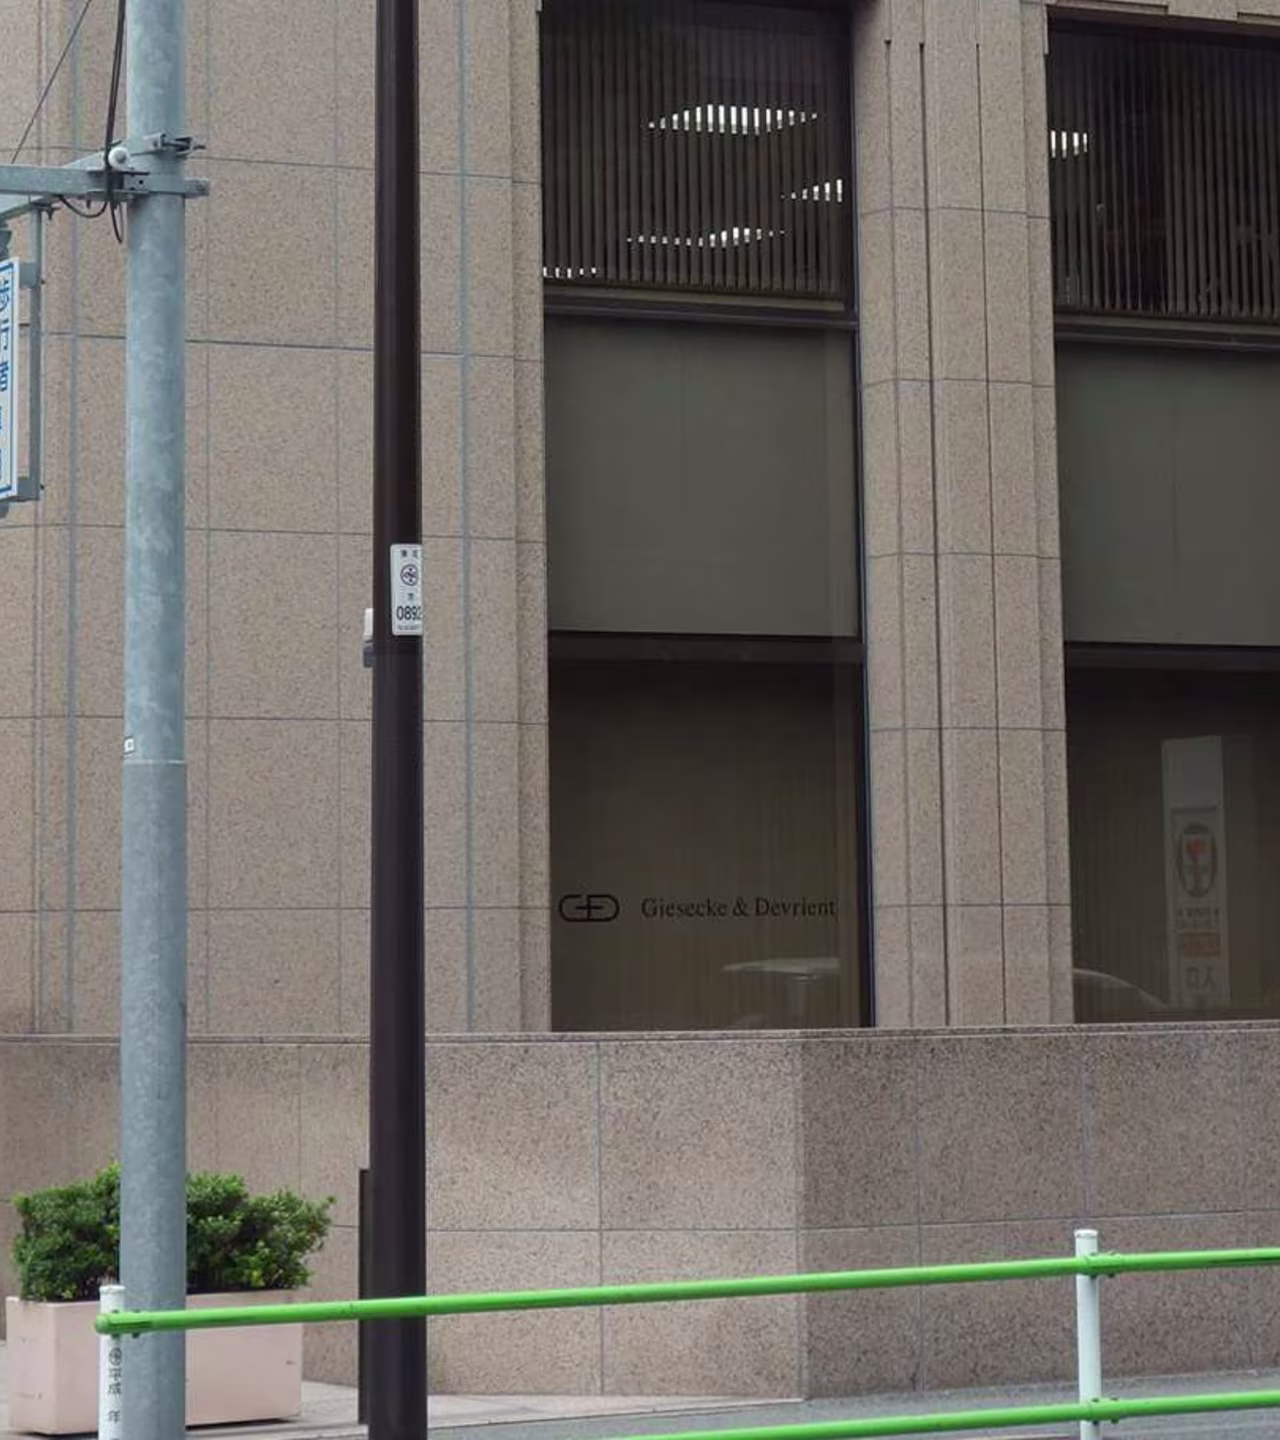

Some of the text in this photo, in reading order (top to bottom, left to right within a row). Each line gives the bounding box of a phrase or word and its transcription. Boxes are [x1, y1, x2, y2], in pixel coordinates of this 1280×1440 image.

[641, 897, 836, 917] Giesecke & Devrient
